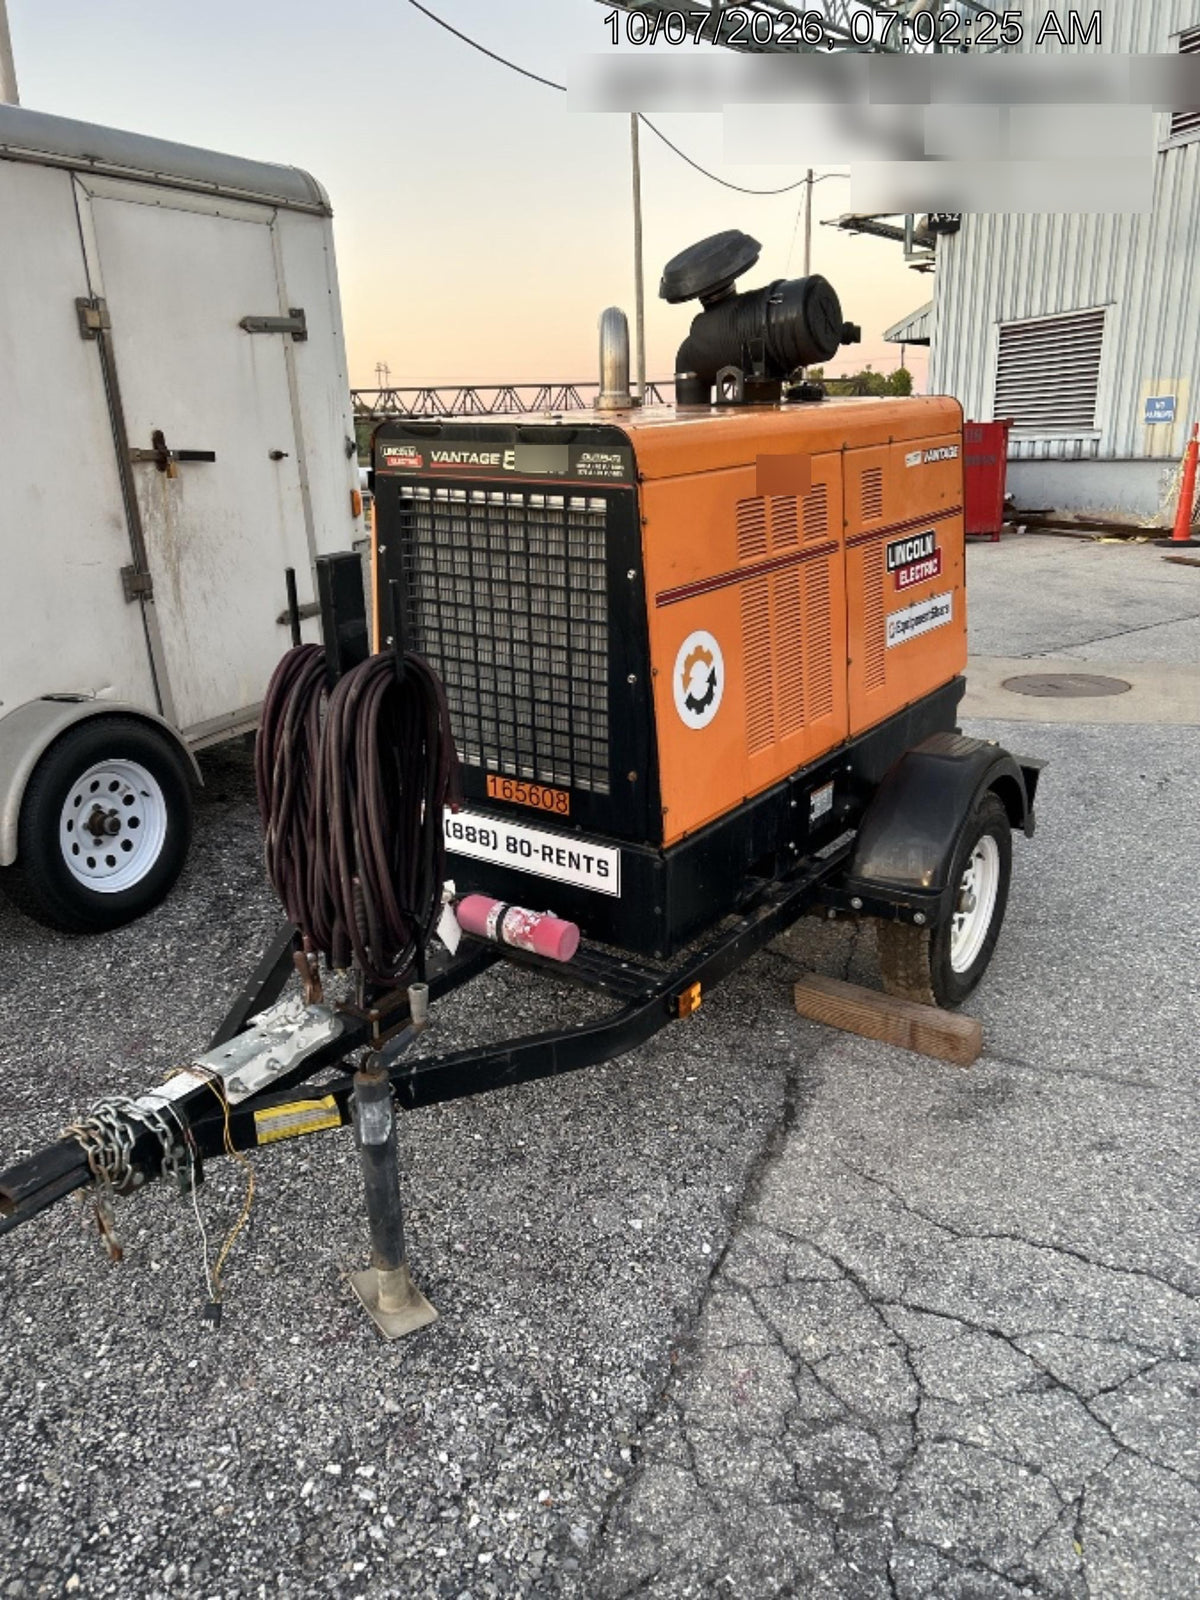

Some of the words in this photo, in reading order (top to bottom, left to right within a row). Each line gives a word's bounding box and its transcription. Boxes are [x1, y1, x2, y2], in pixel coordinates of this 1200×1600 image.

[431, 450, 501, 465] VANTAGE
[888, 534, 933, 568] LINCOLN
[899, 558, 938, 586] ELECTRIC
[489, 778, 568, 813] 165608
[445, 819, 497, 850] (888)
